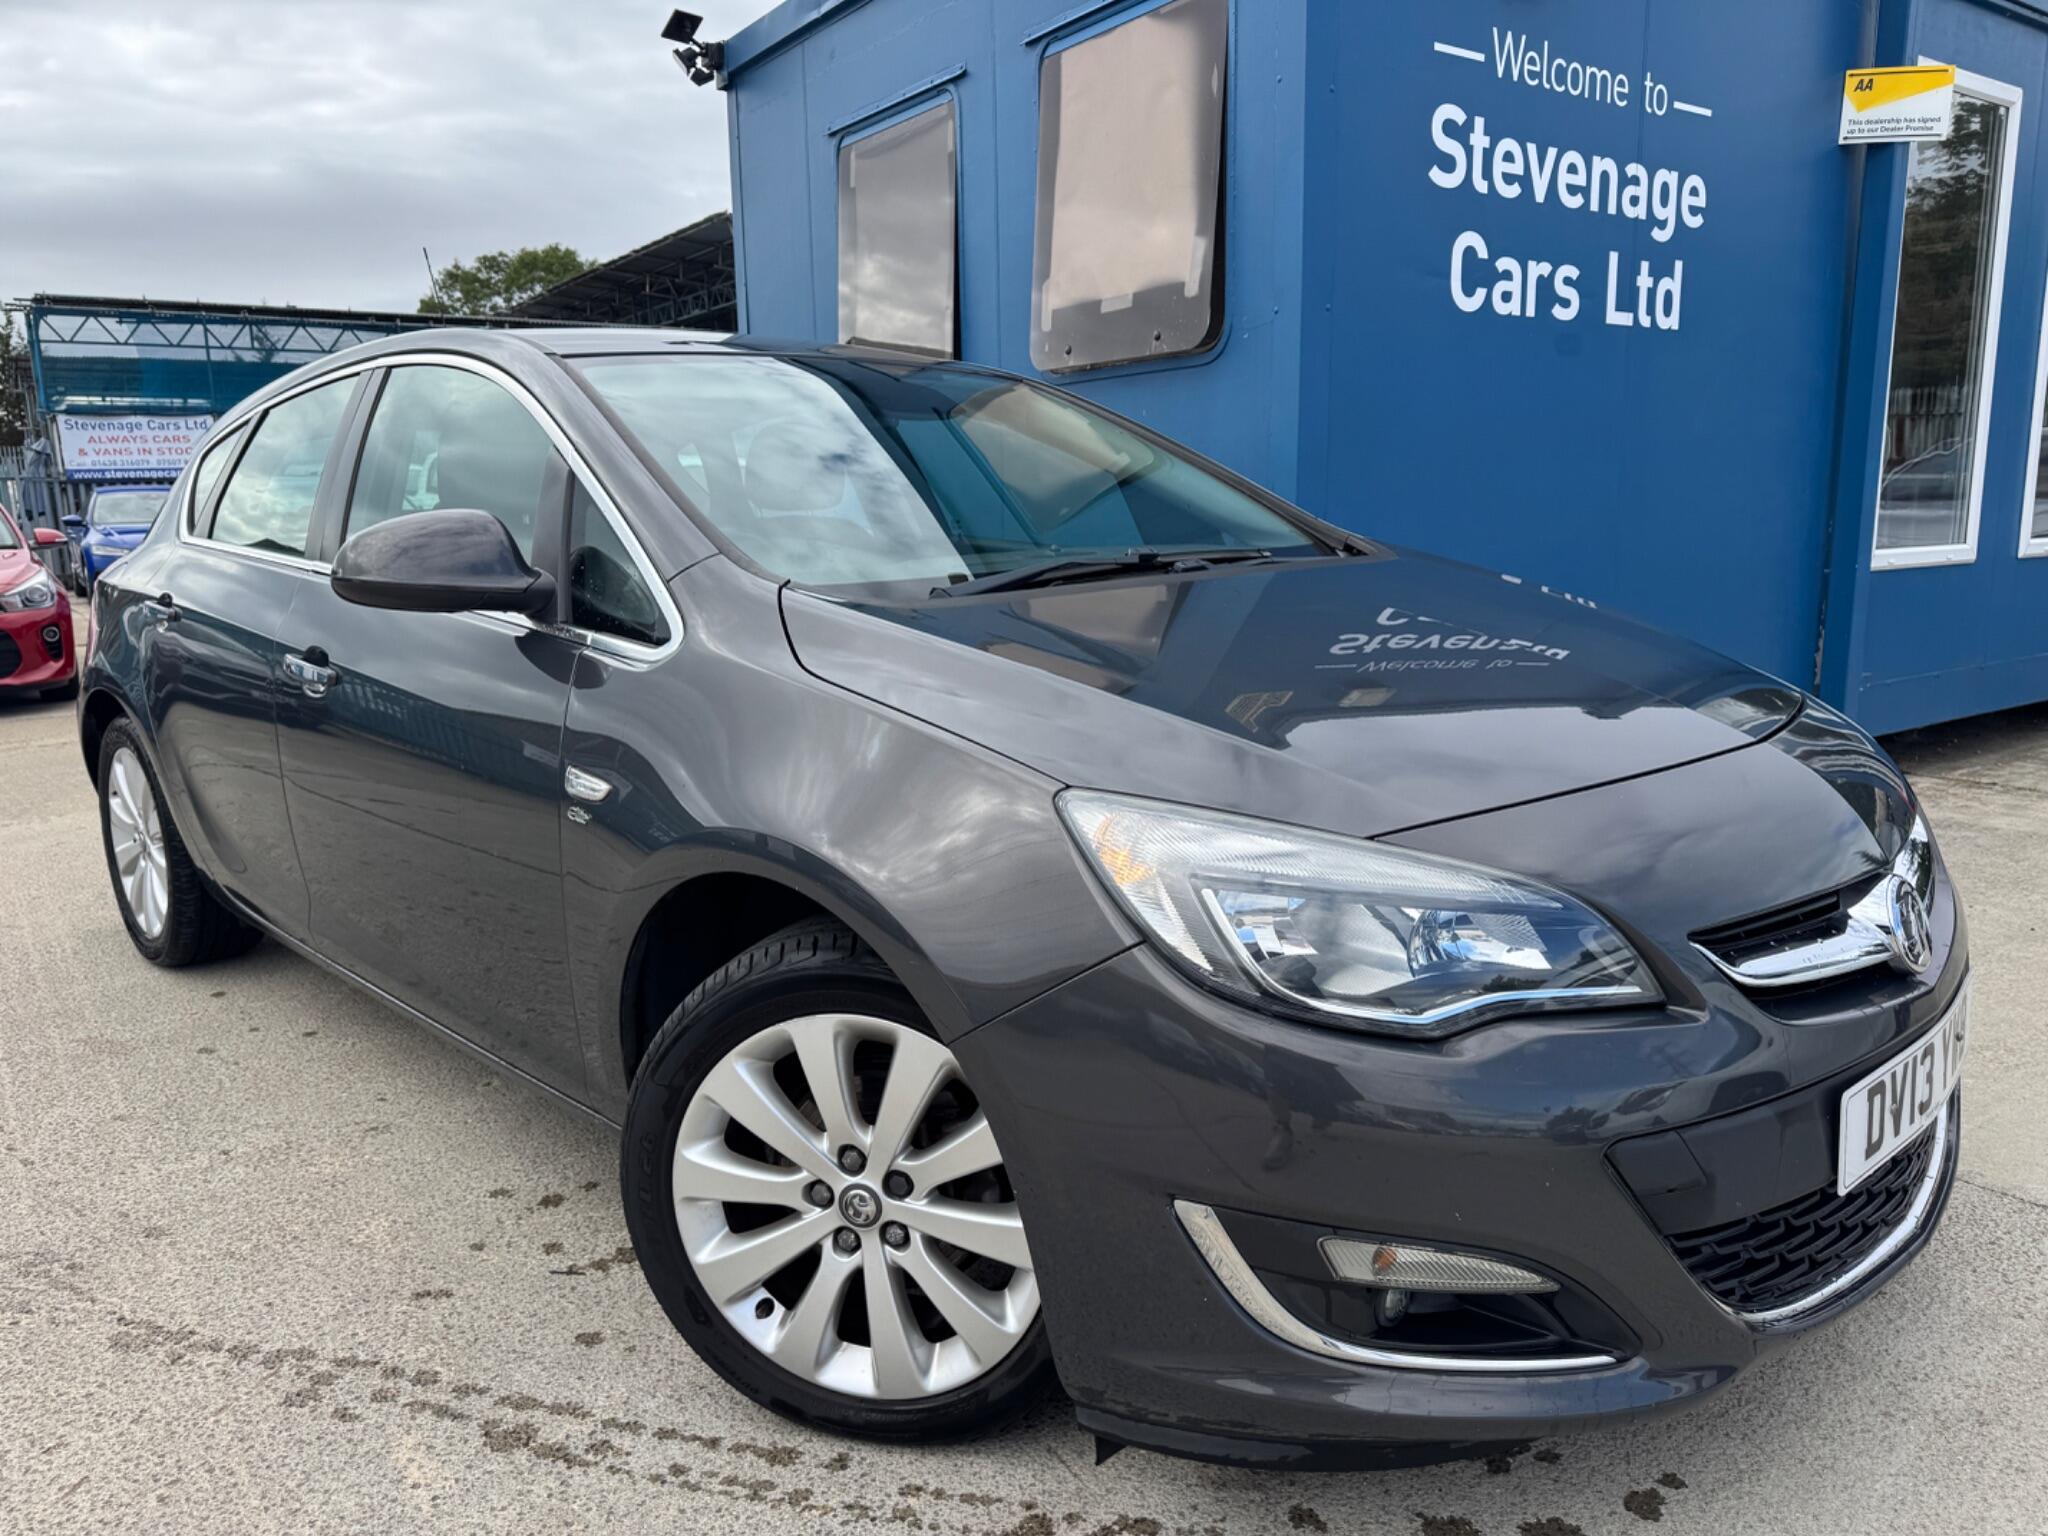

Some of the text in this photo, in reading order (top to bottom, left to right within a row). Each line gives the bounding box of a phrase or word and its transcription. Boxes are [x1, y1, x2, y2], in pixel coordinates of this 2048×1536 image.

[1492, 26, 1668, 116] Welcome to
[1854, 78, 1874, 92] AA
[1848, 118, 1864, 126] This
[1864, 117, 1902, 126] dealership
[1917, 116, 1942, 125] signed
[1847, 127, 1856, 135] up
[1857, 126, 1866, 134] to
[1880, 125, 1904, 133] Dealer
[1905, 124, 1934, 132] Promise
[1428, 102, 1707, 243] Stevenage
[1449, 230, 1684, 330] Cars Ltd
[64, 418, 208, 433] Stevenage Cars Ltd
[87, 434, 191, 444] ALWAYS CARS
[78, 446, 194, 457] & VANS IN STOC
[73, 470, 182, 479] www.stevenagecar
[1864, 1039, 1935, 1161] DV13
